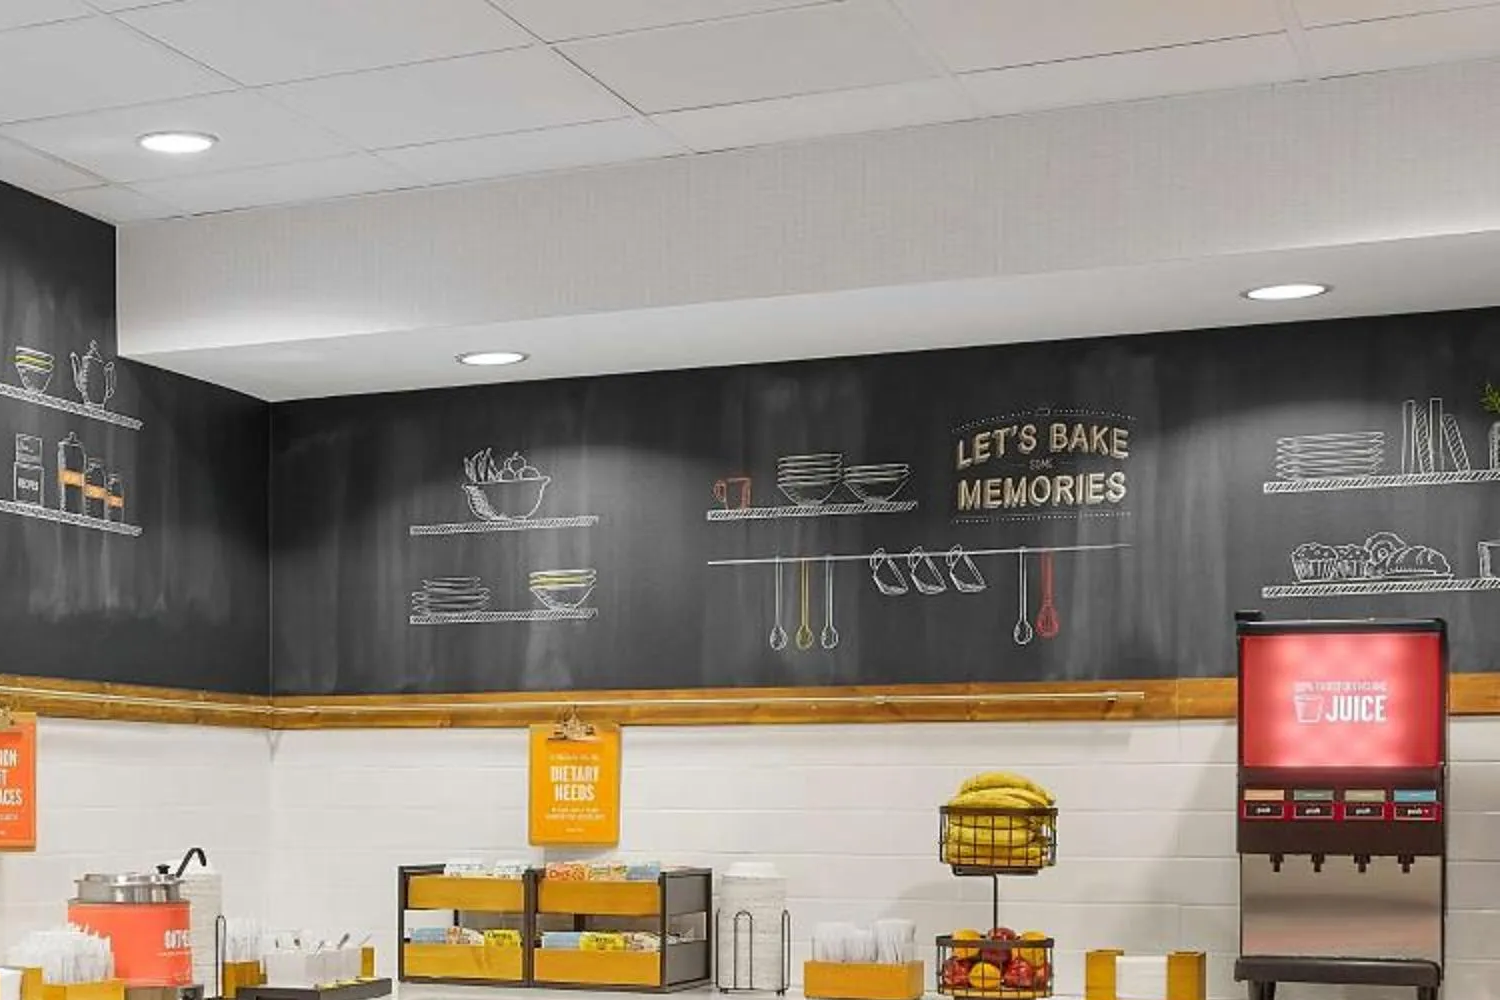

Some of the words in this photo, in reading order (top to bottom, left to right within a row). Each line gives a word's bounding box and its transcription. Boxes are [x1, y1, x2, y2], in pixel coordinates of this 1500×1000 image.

[956, 424, 1039, 469] LET'S
[1050, 422, 1129, 460] BAKE
[957, 471, 1127, 511] MEMORIES
[1325, 695, 1388, 722] JUICE
[550, 765, 600, 783] DIETARY
[554, 783, 596, 801] NEEDS
